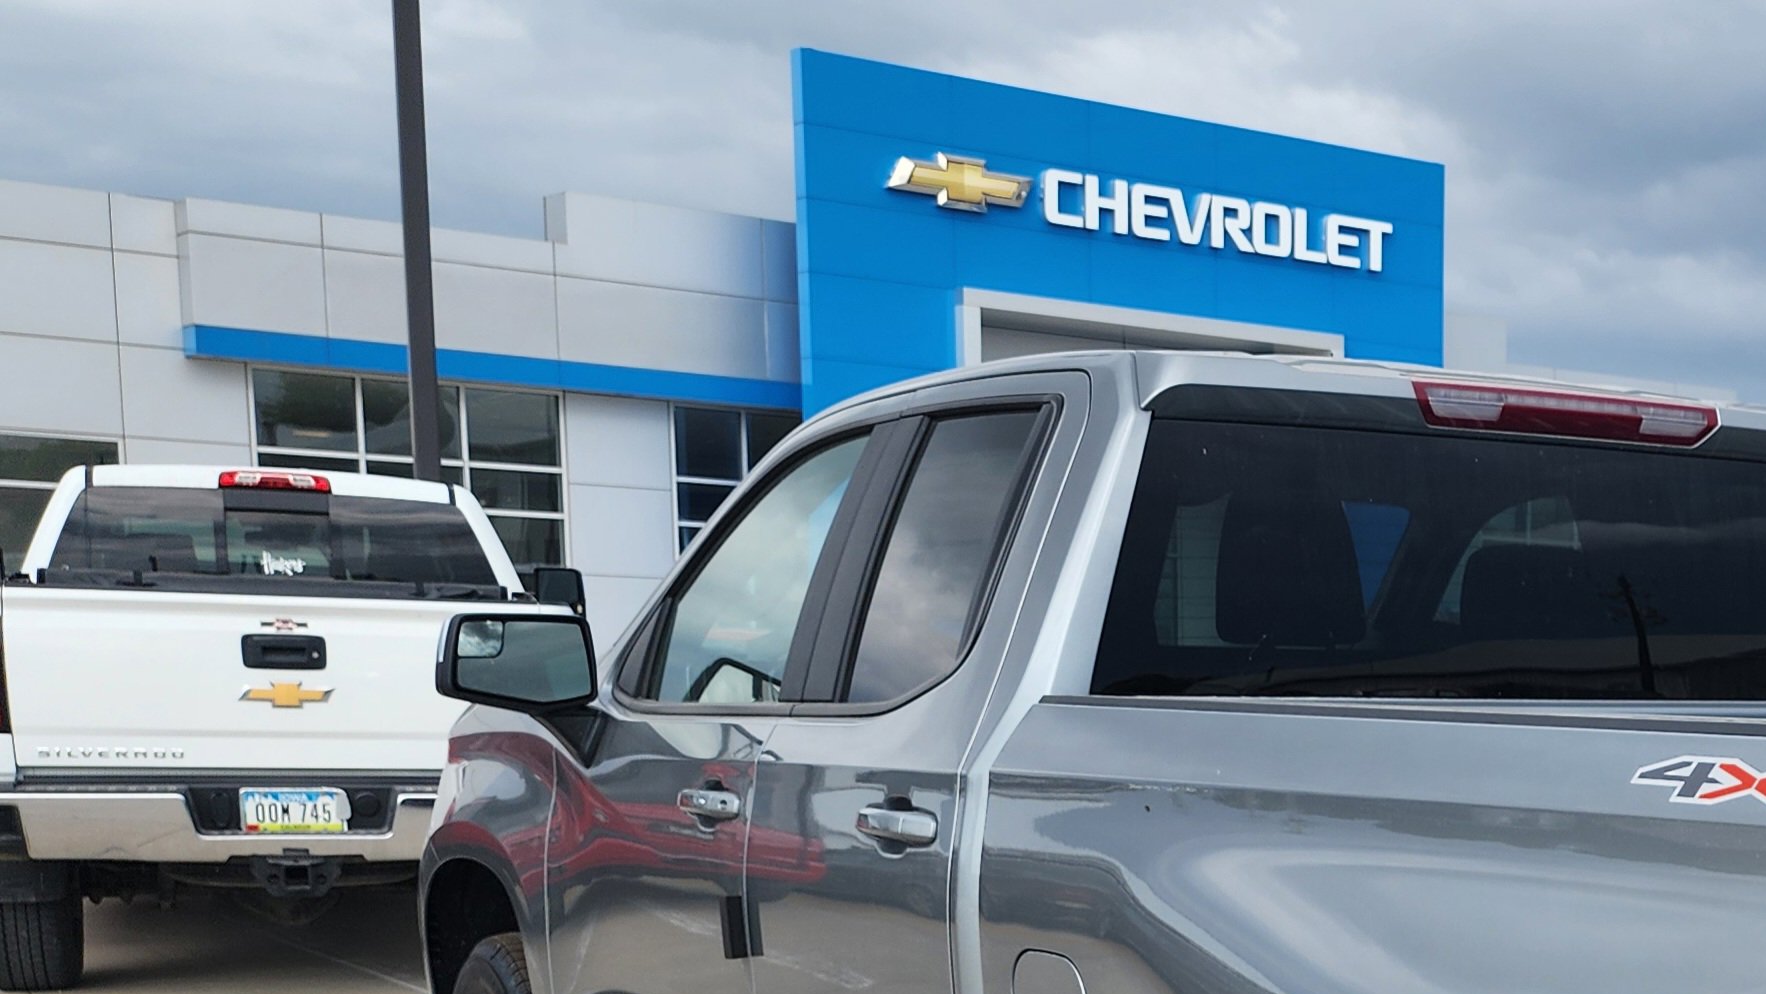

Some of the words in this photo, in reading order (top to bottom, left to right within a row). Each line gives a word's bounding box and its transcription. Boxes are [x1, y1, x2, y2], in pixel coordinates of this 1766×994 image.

[1041, 167, 1393, 273] CHEVROLET
[37, 746, 185, 759] SILVERADO
[300, 803, 331, 823] 745
